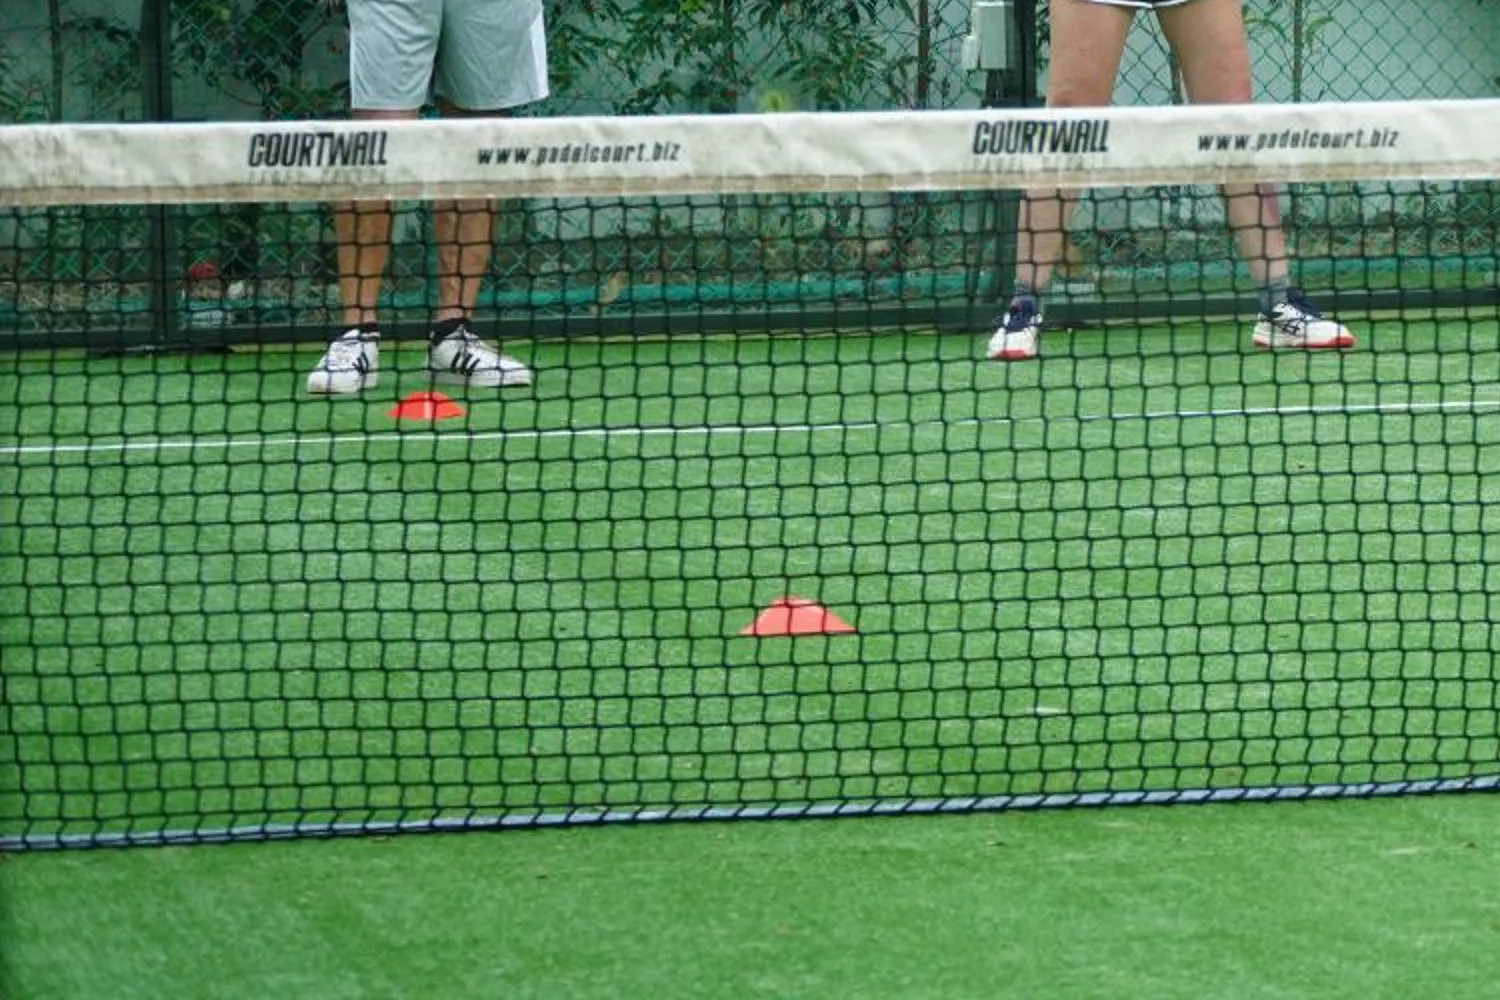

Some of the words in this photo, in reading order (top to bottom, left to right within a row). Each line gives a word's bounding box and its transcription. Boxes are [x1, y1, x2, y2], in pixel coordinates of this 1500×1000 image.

[247, 131, 389, 168] COURTWALL
[972, 119, 1110, 155] COURTWALL
[1197, 129, 1399, 152] www.padelcourt.biz
[477, 142, 682, 166] www.padelcourt.biz
